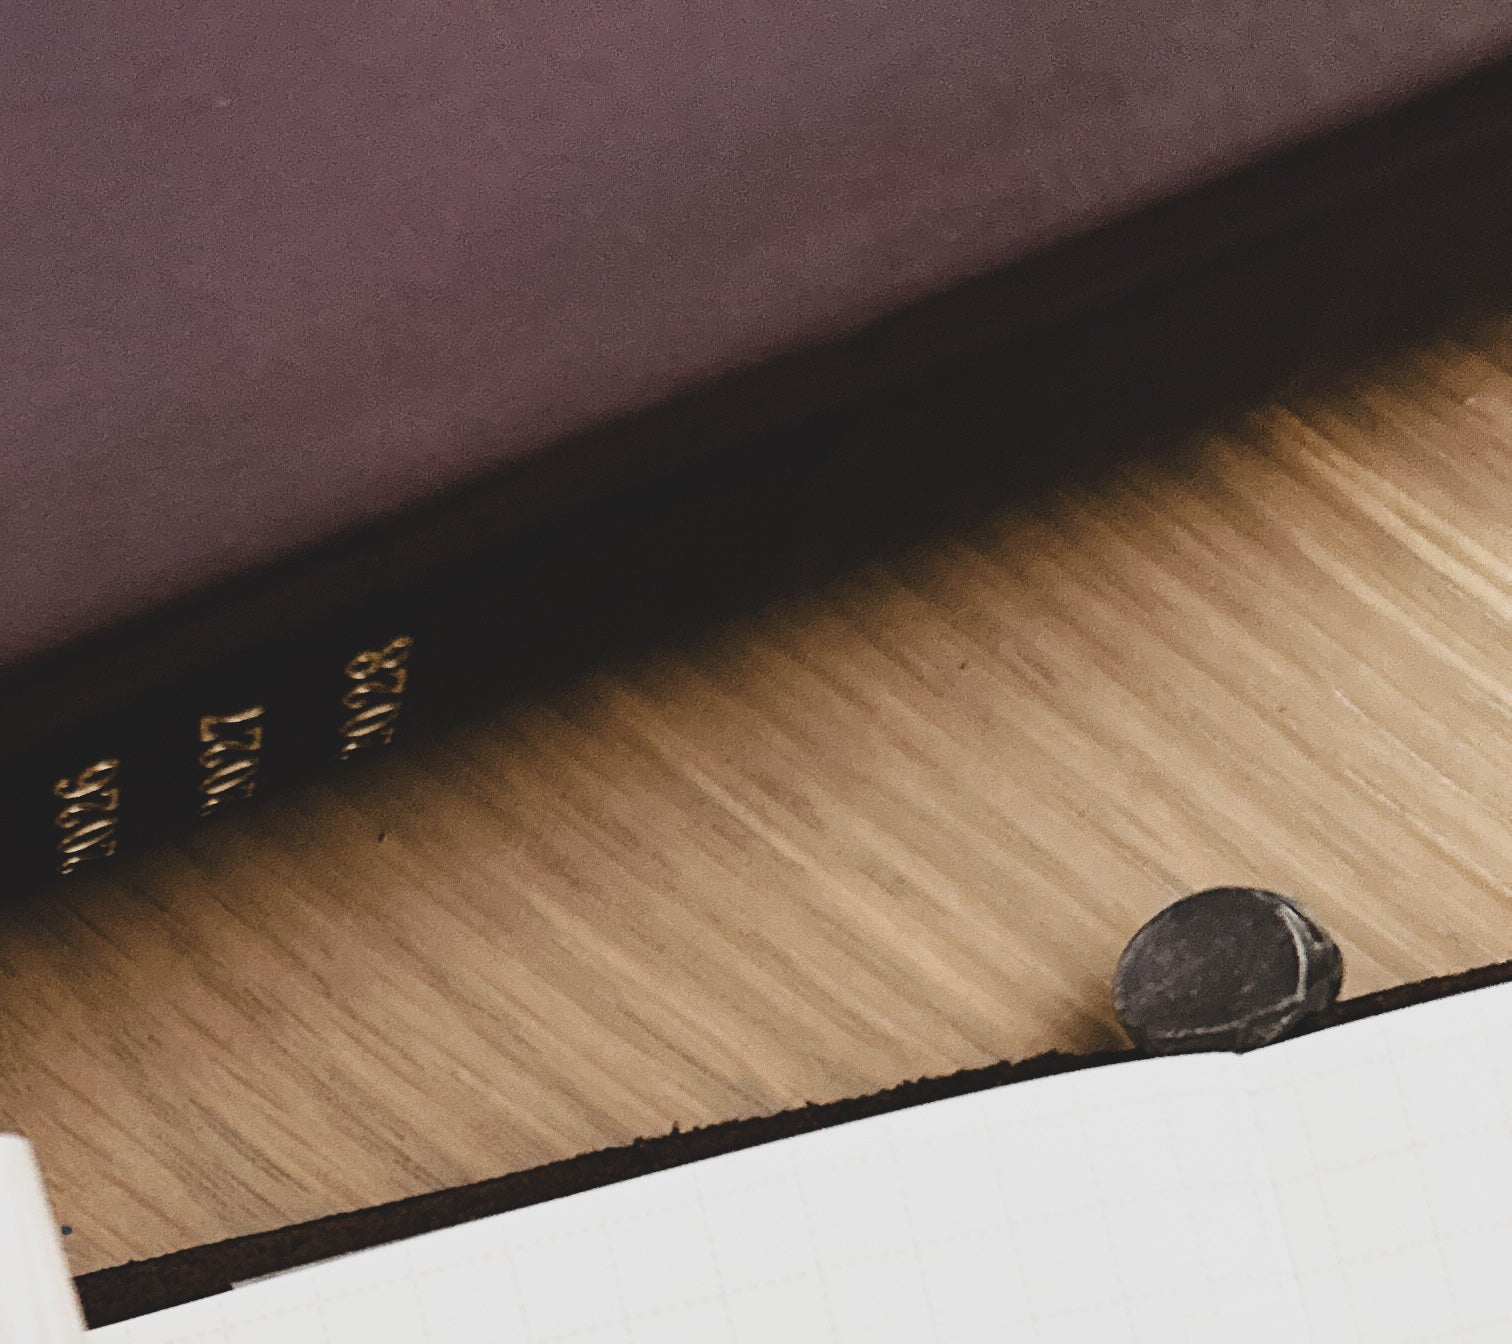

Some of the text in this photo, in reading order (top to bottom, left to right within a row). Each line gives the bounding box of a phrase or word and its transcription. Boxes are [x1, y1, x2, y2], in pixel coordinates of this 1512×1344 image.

[335, 635, 413, 761] 2028
[52, 757, 120, 876] 2026
[197, 705, 266, 818] 2027
